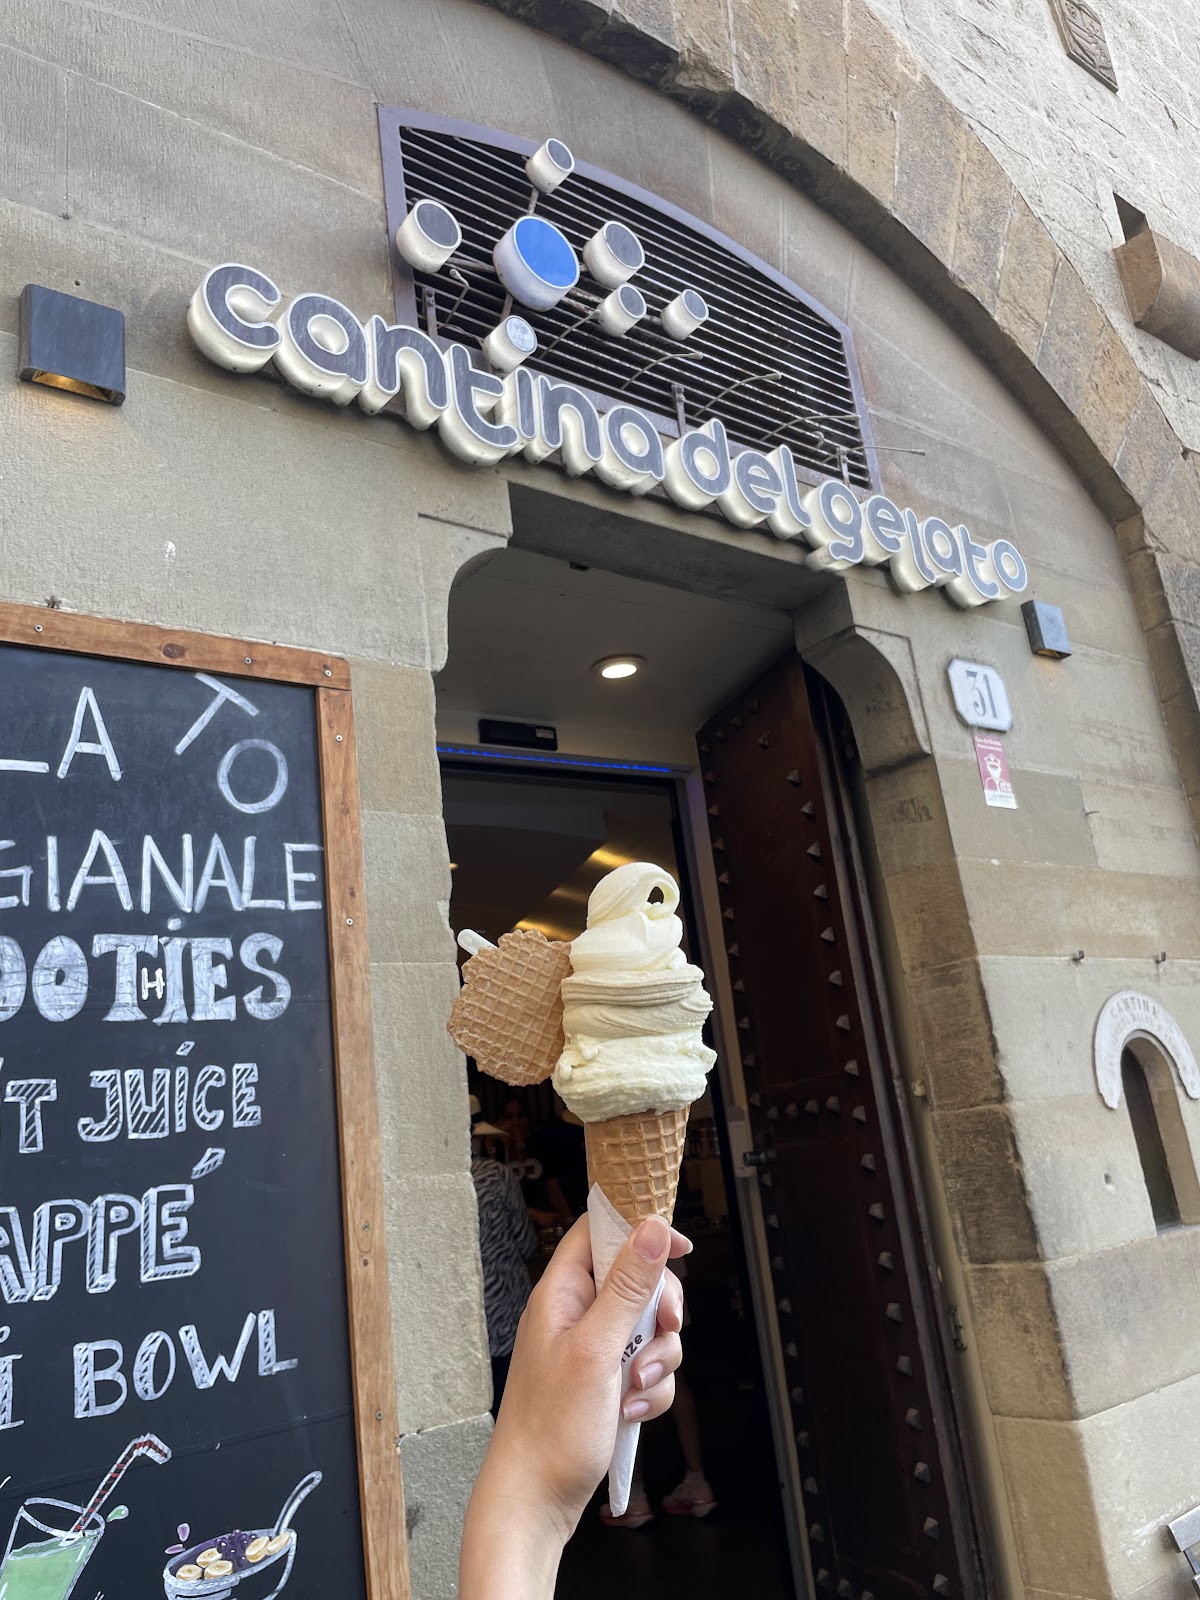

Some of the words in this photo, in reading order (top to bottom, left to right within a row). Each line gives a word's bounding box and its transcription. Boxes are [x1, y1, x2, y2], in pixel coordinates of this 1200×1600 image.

[964, 669, 998, 719] 31
[77, 1041, 262, 1142] JUICE
[73, 1308, 299, 1419] BOWL
